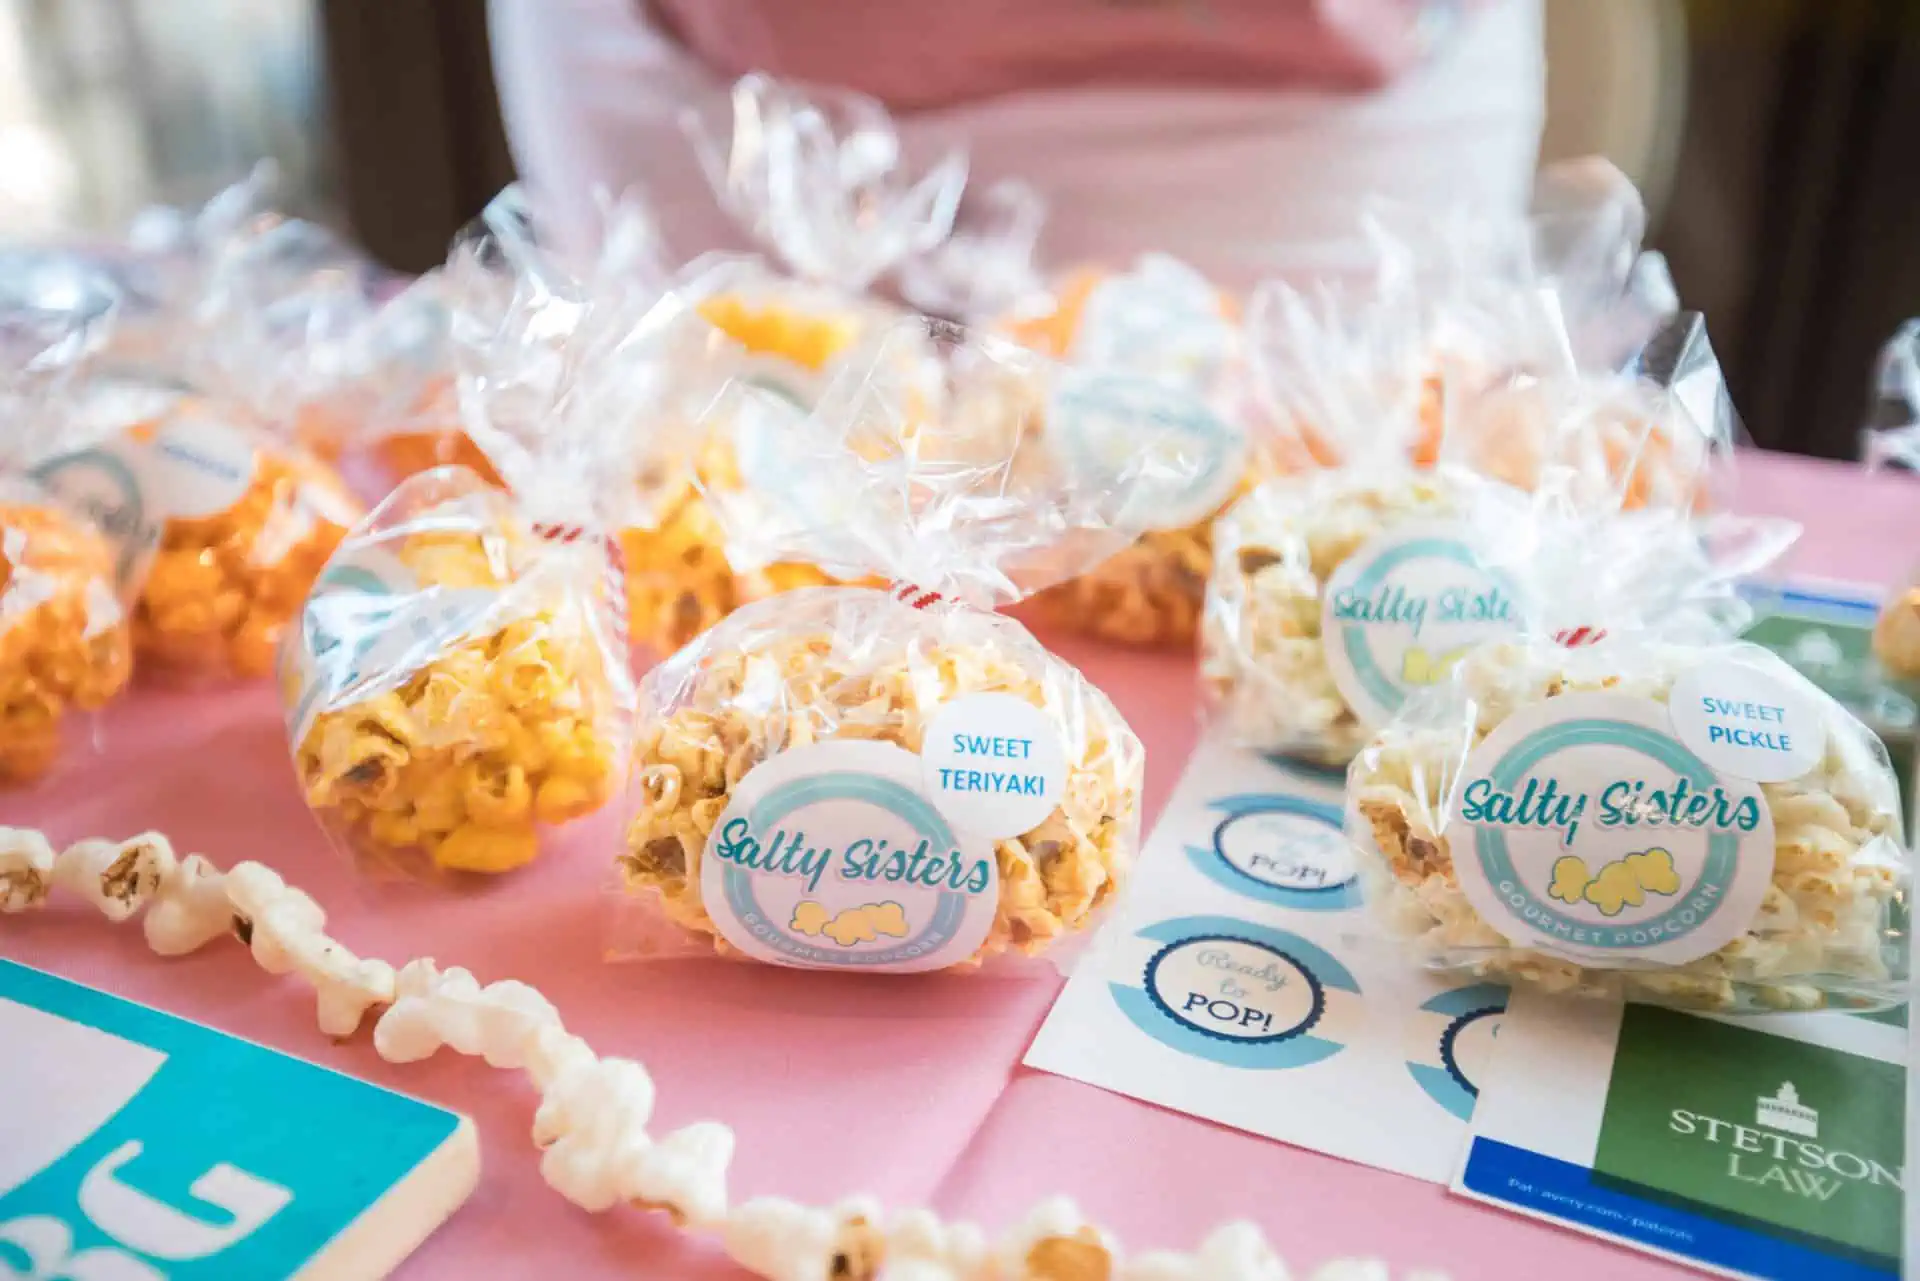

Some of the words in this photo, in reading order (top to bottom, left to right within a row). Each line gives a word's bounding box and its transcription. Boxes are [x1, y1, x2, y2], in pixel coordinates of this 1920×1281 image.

[1333, 583, 1428, 640] Salty
[1703, 695, 1784, 724] SWEET
[952, 732, 1032, 759] SWEET
[1708, 725, 1792, 751] PICKLE
[938, 767, 1045, 797] TERIYAKI
[1463, 777, 1587, 844] Salty
[1599, 779, 1760, 832] Sisters
[715, 817, 833, 892] Salty
[841, 838, 990, 894] Sisters
[1499, 879, 1602, 944] GOURMET
[1614, 883, 1722, 945] POPCORN
[1196, 949, 1288, 992] Ready
[1220, 978, 1249, 998] to
[1183, 992, 1275, 1032] POP!
[1668, 1108, 1906, 1193] STETSON
[1727, 1152, 1843, 1202] LAW
